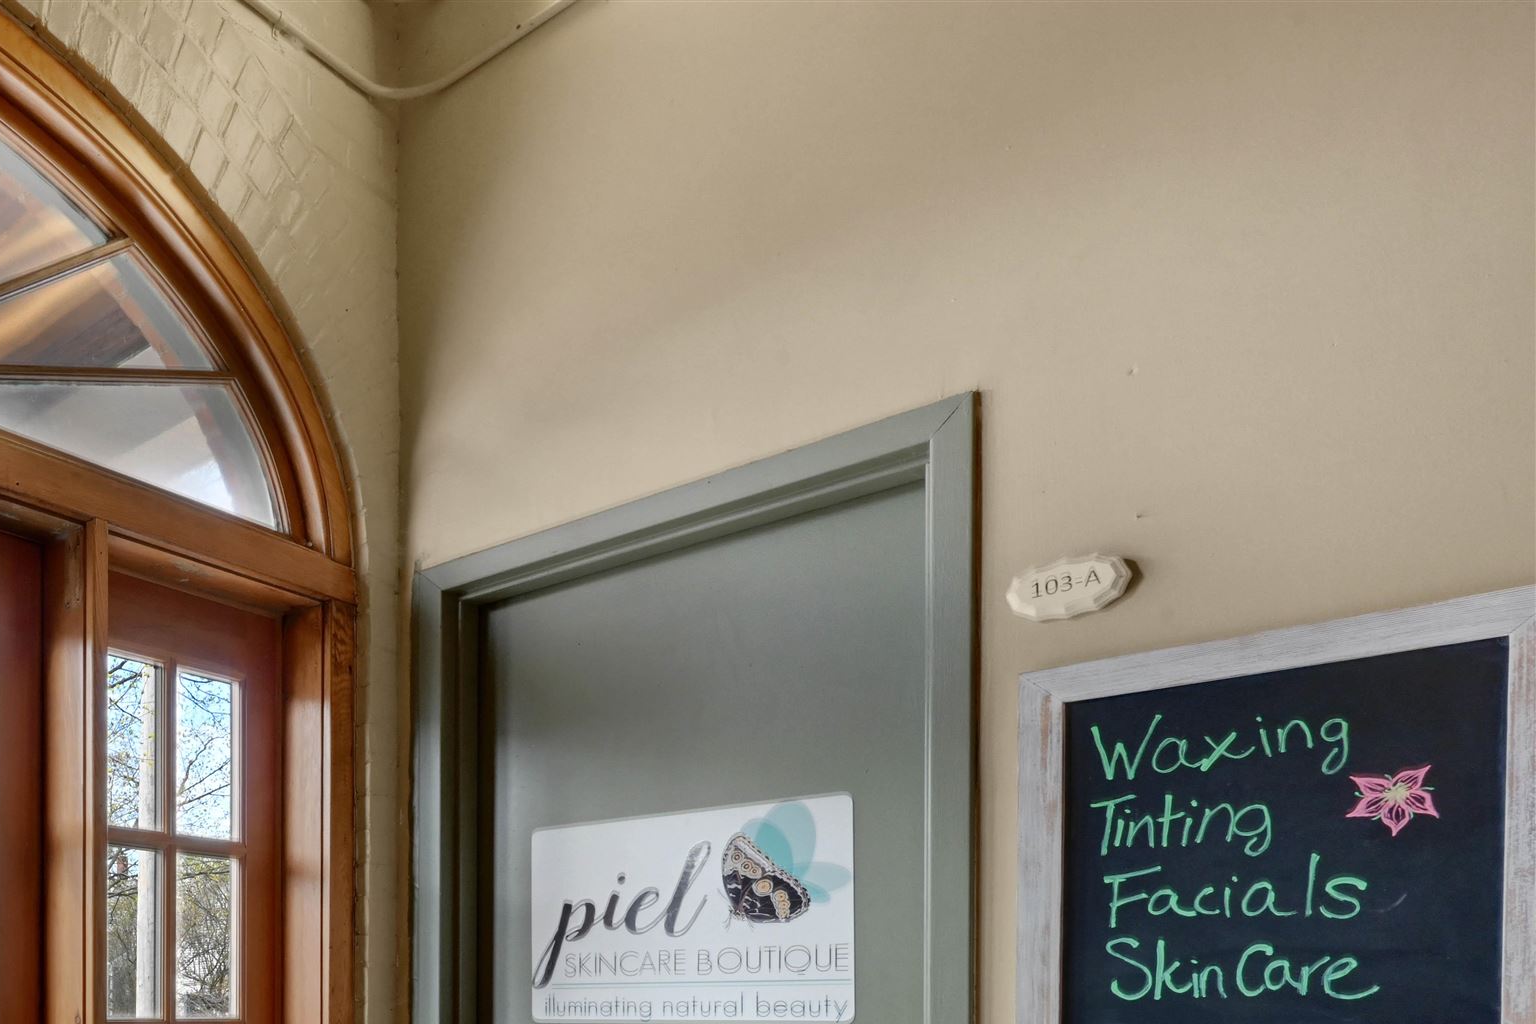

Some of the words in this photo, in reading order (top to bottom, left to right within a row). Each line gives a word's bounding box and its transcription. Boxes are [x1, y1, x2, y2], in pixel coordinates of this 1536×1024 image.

[1030, 568, 1102, 599] 103-A
[1090, 714, 1350, 780] Waxing
[1090, 794, 1272, 856] Tinting
[533, 841, 711, 989] piel
[1103, 853, 1368, 928] Facials
[564, 949, 686, 978] SKINCARE
[697, 943, 850, 976] BOUTIQUE
[544, 992, 653, 1022] illuminating
[662, 991, 744, 1018] natural
[756, 991, 849, 1023] beauty
